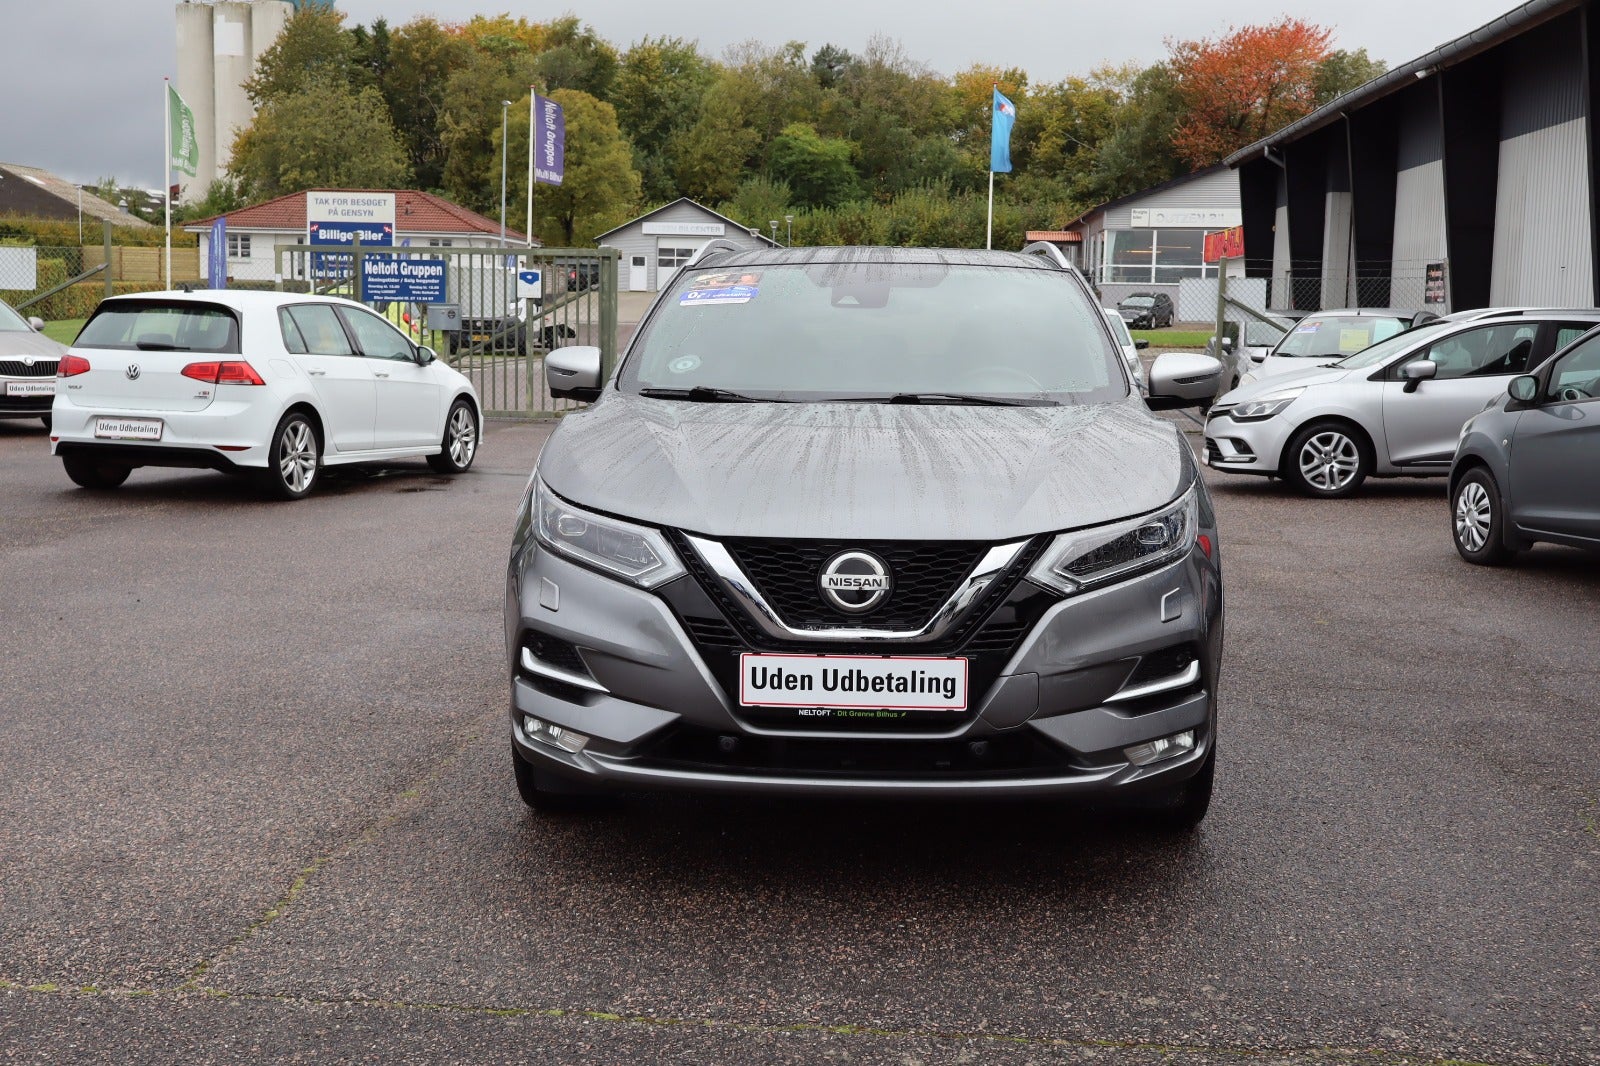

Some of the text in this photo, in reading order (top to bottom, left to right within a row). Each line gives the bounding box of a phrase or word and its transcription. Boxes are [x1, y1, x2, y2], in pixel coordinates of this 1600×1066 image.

[544, 100, 558, 167] Neltoft Gruppen
[314, 197, 388, 207] TAK FOR BESØGET
[328, 207, 374, 217] PÅ GENSYN
[318, 229, 384, 242] Billige Biler
[364, 261, 399, 275] Neltoft
[400, 261, 443, 279] Gruppen
[25, 385, 56, 393] Udbetaling
[99, 422, 159, 435] Uden Udbetaling
[828, 577, 882, 588] NISSAN
[751, 666, 957, 700] Uden Udbetaling
[798, 709, 831, 717] NELTOFT
[849, 710, 875, 718] Grønne
